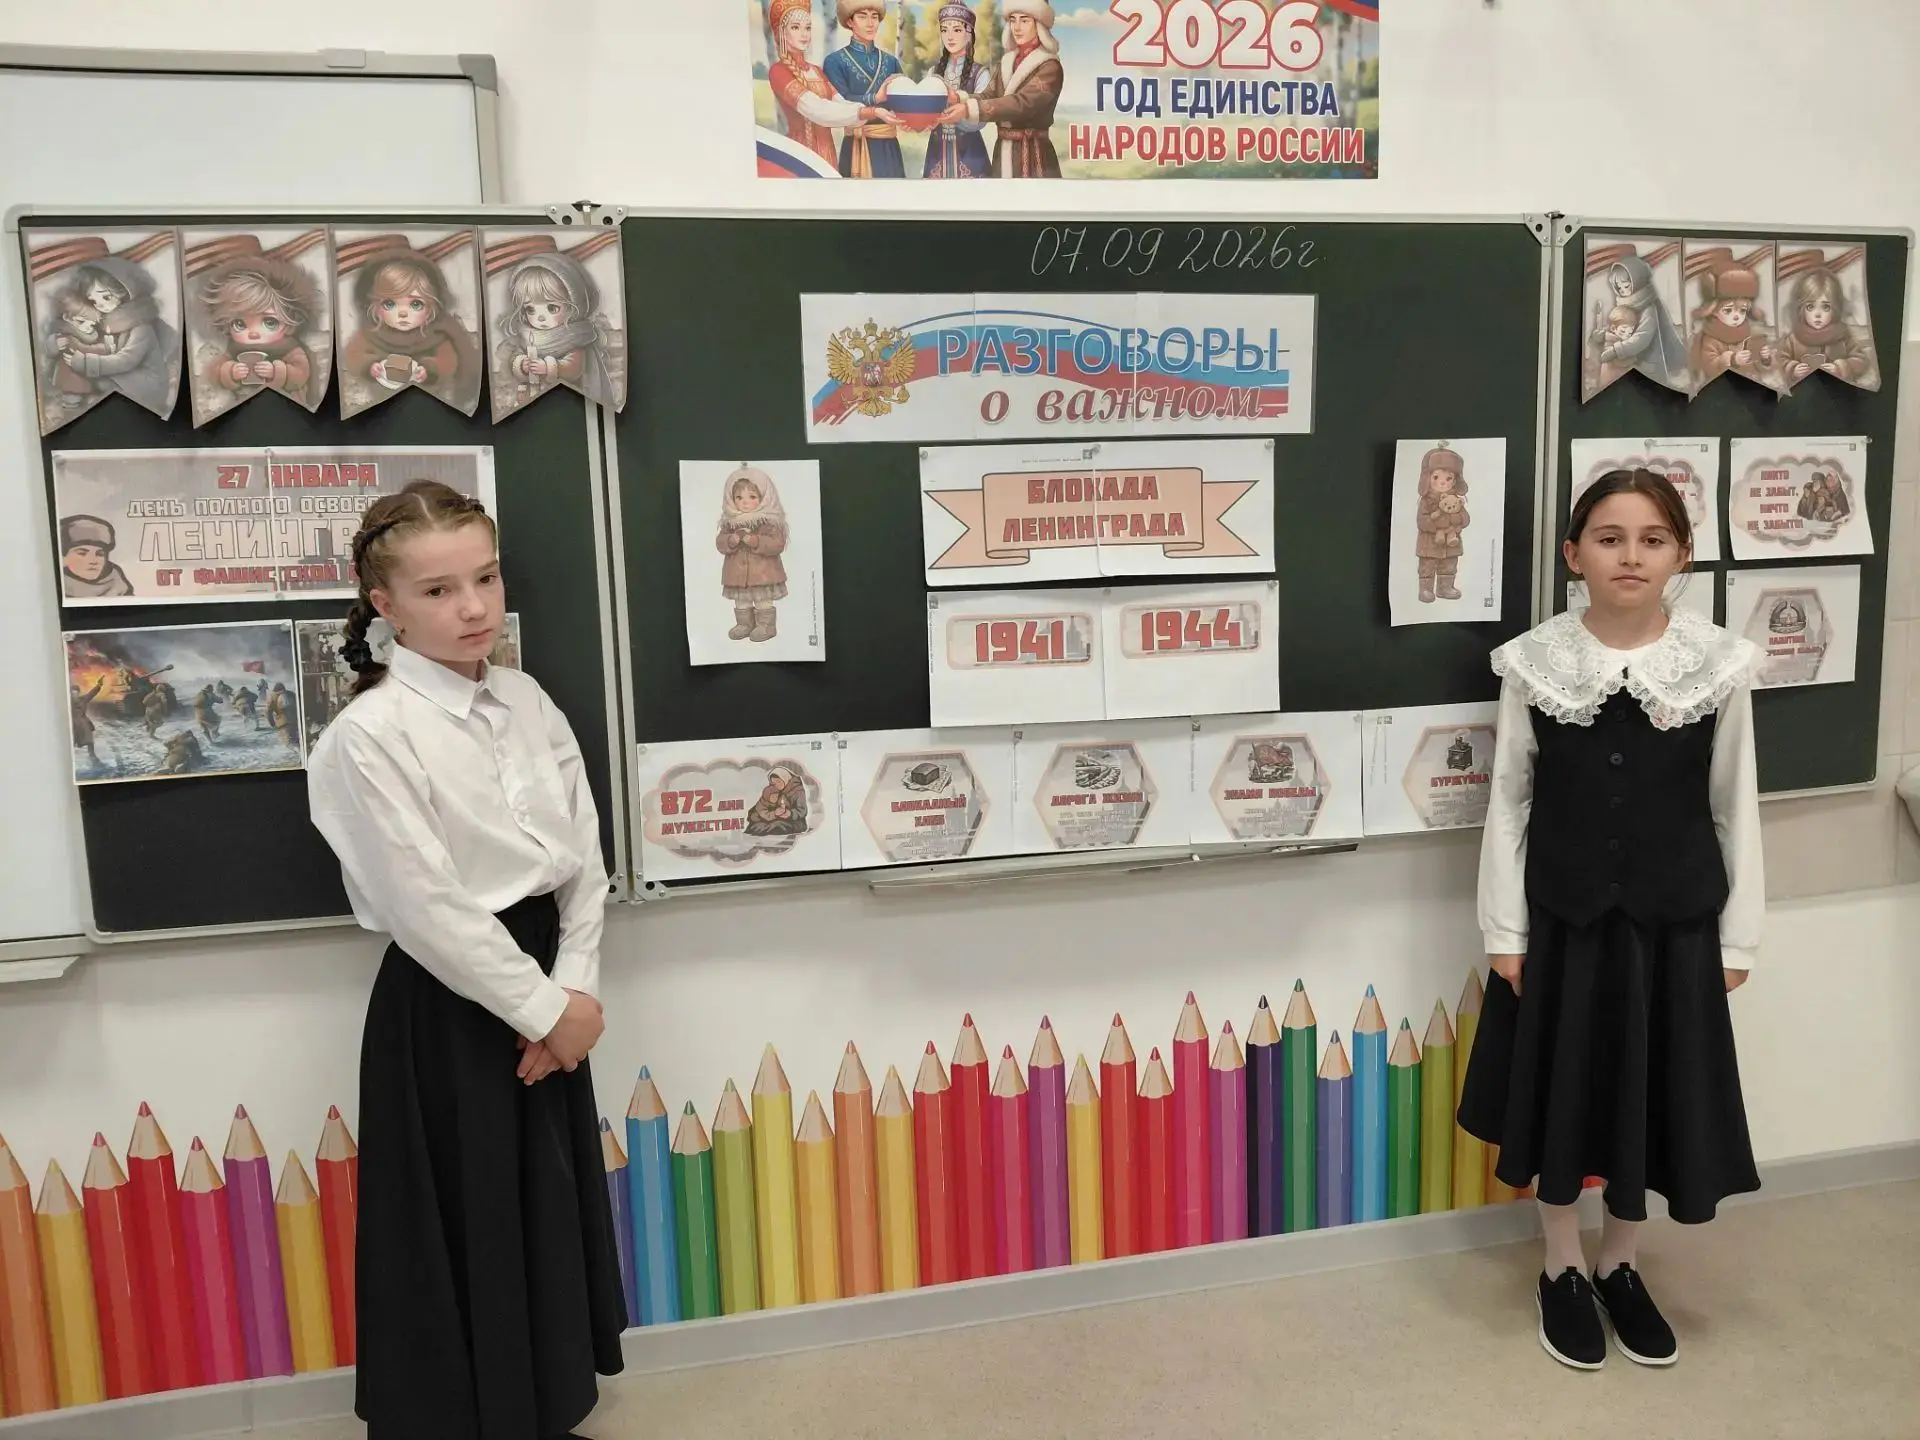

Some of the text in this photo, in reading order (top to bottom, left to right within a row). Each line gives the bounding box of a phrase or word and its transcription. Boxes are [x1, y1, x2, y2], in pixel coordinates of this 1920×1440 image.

[1109, 0, 1324, 71] 2026
[1096, 76, 1339, 118] ГОД ЕДИНСТВА
[1070, 124, 1364, 166] НАРОДОВ РОССИИ
[937, 326, 1279, 376] РАЗГОВОРЫ
[980, 384, 1264, 423] о важном
[216, 463, 378, 489] 27 ЯНВАРЯ
[1027, 476, 1160, 505] БЛОКАДА
[127, 498, 185, 518] ДЕНЬ
[194, 496, 290, 517] ПОЛНОГО
[1750, 487, 1762, 498] НЕ
[139, 517, 362, 562] ЛЕНИНГР
[1003, 512, 1186, 543] ЛЕНИНГРАДА
[156, 568, 183, 587] ОТ
[975, 619, 1065, 663] 1941
[1141, 608, 1241, 651] 1944
[660, 789, 713, 816] 872
[661, 817, 745, 836] МУЖЕСТВА!
